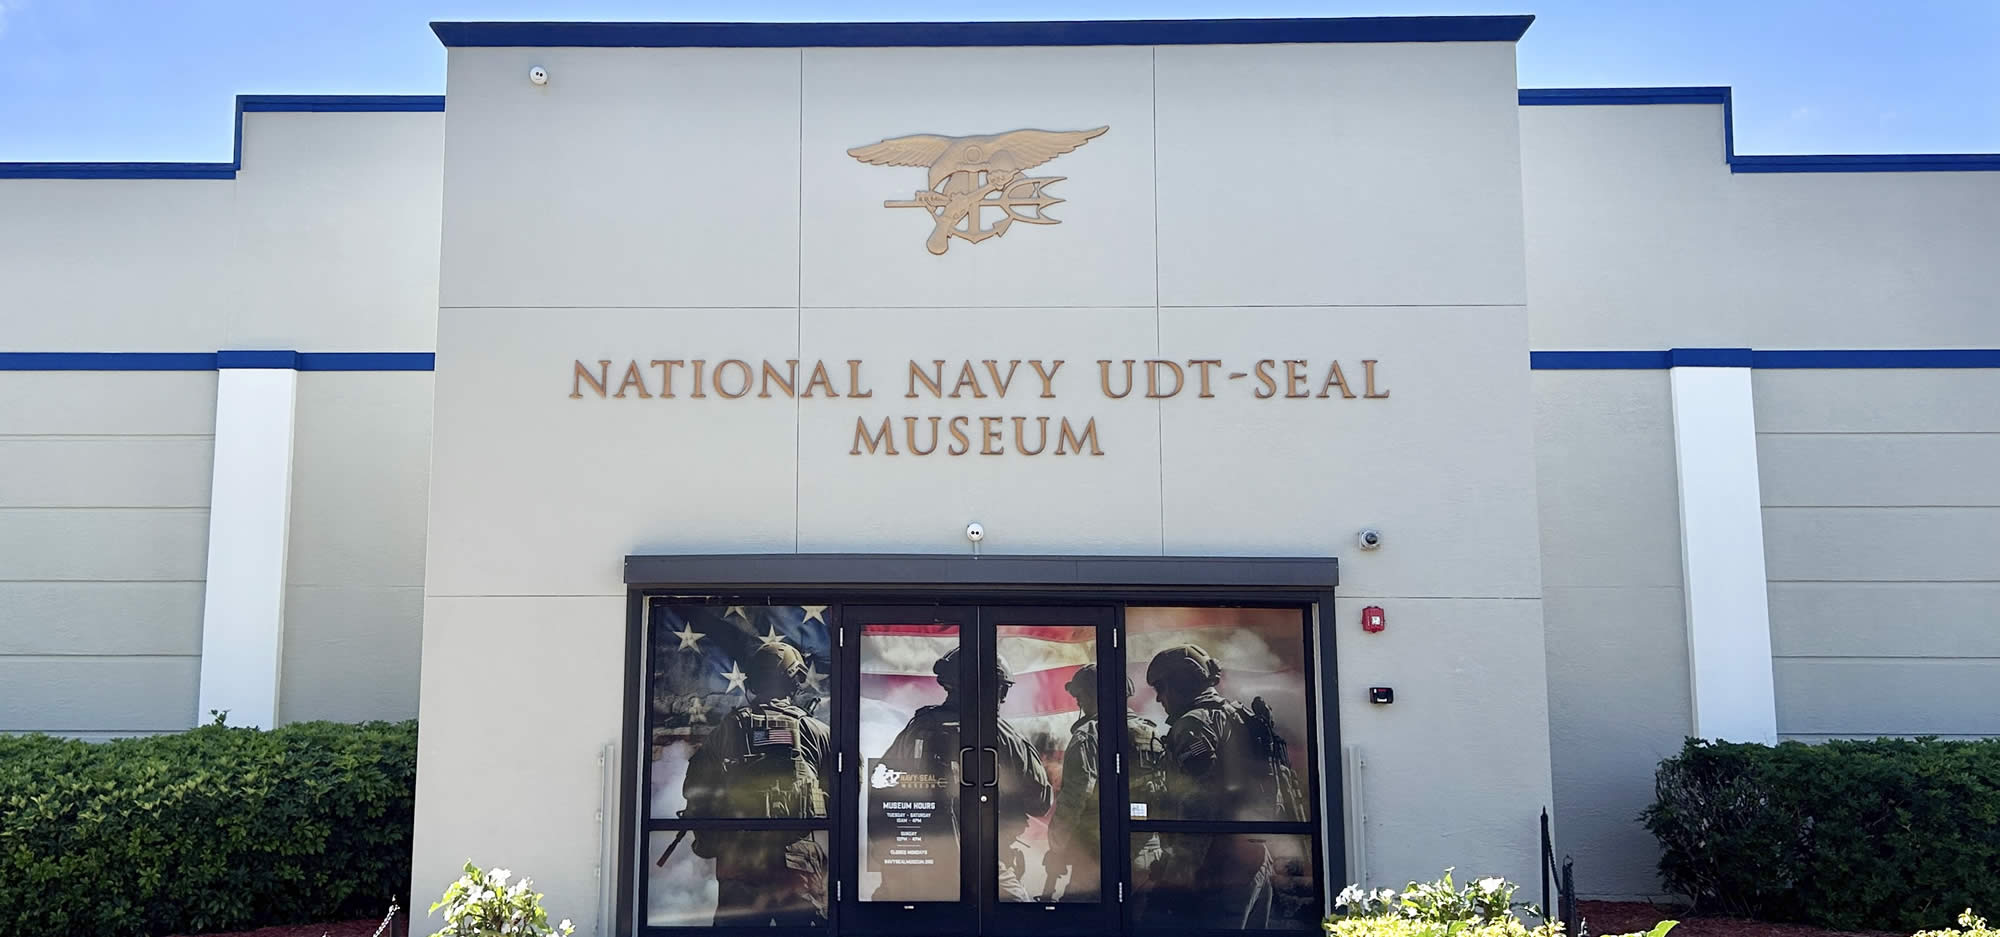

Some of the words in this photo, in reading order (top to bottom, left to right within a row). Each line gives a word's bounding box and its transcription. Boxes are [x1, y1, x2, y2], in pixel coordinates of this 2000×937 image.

[570, 359, 873, 400] NATIONAL
[906, 359, 1063, 399] NAVY
[1099, 359, 1391, 400] UDT-SEAL
[850, 416, 1105, 457] MUSEUM
